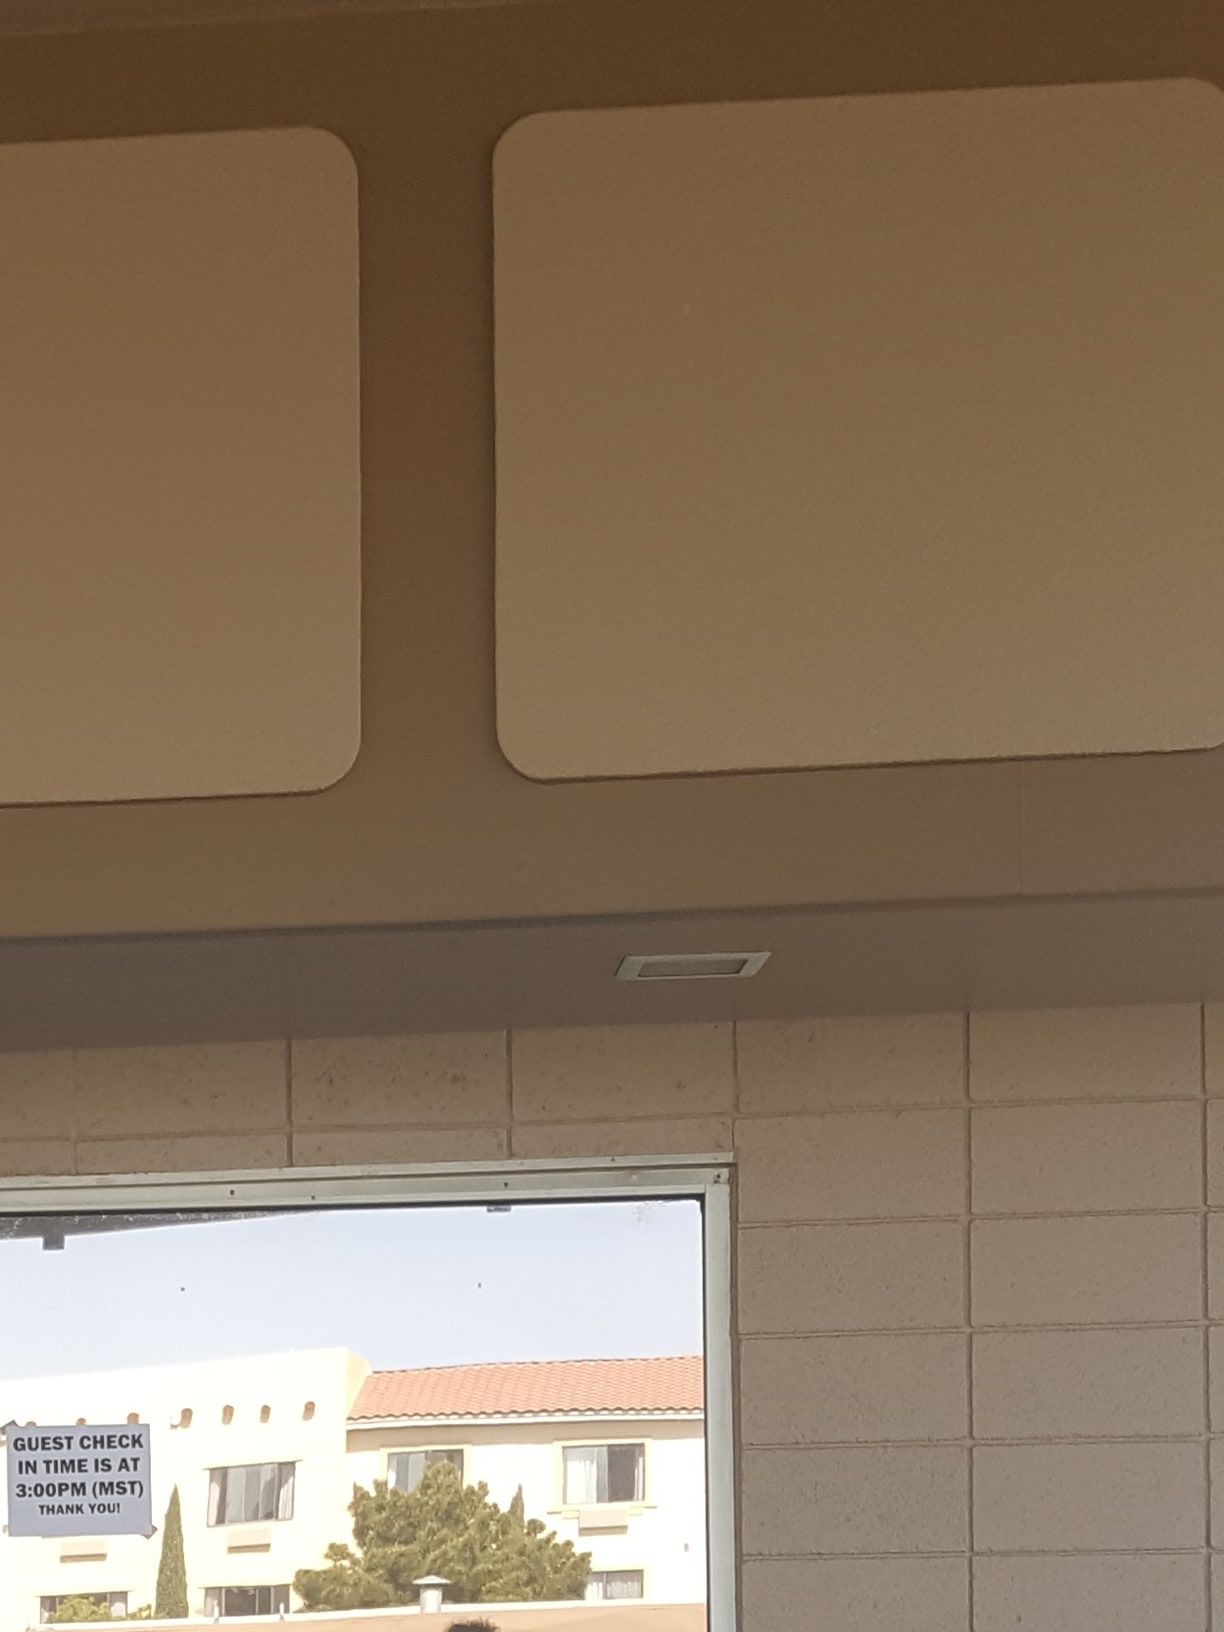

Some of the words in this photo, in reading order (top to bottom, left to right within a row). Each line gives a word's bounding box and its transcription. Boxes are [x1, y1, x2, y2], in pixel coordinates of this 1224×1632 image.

[13, 1436, 74, 1451] GUEST
[79, 1434, 144, 1449] CHECK
[18, 1460, 37, 1475] IN
[43, 1458, 88, 1474] TIME
[94, 1458, 112, 1473] IS
[117, 1457, 140, 1472] AT
[15, 1482, 87, 1498] 3:00PM
[92, 1480, 144, 1499] (MST)
[38, 1503, 84, 1516] THANK
[88, 1502, 121, 1515] YOU!
